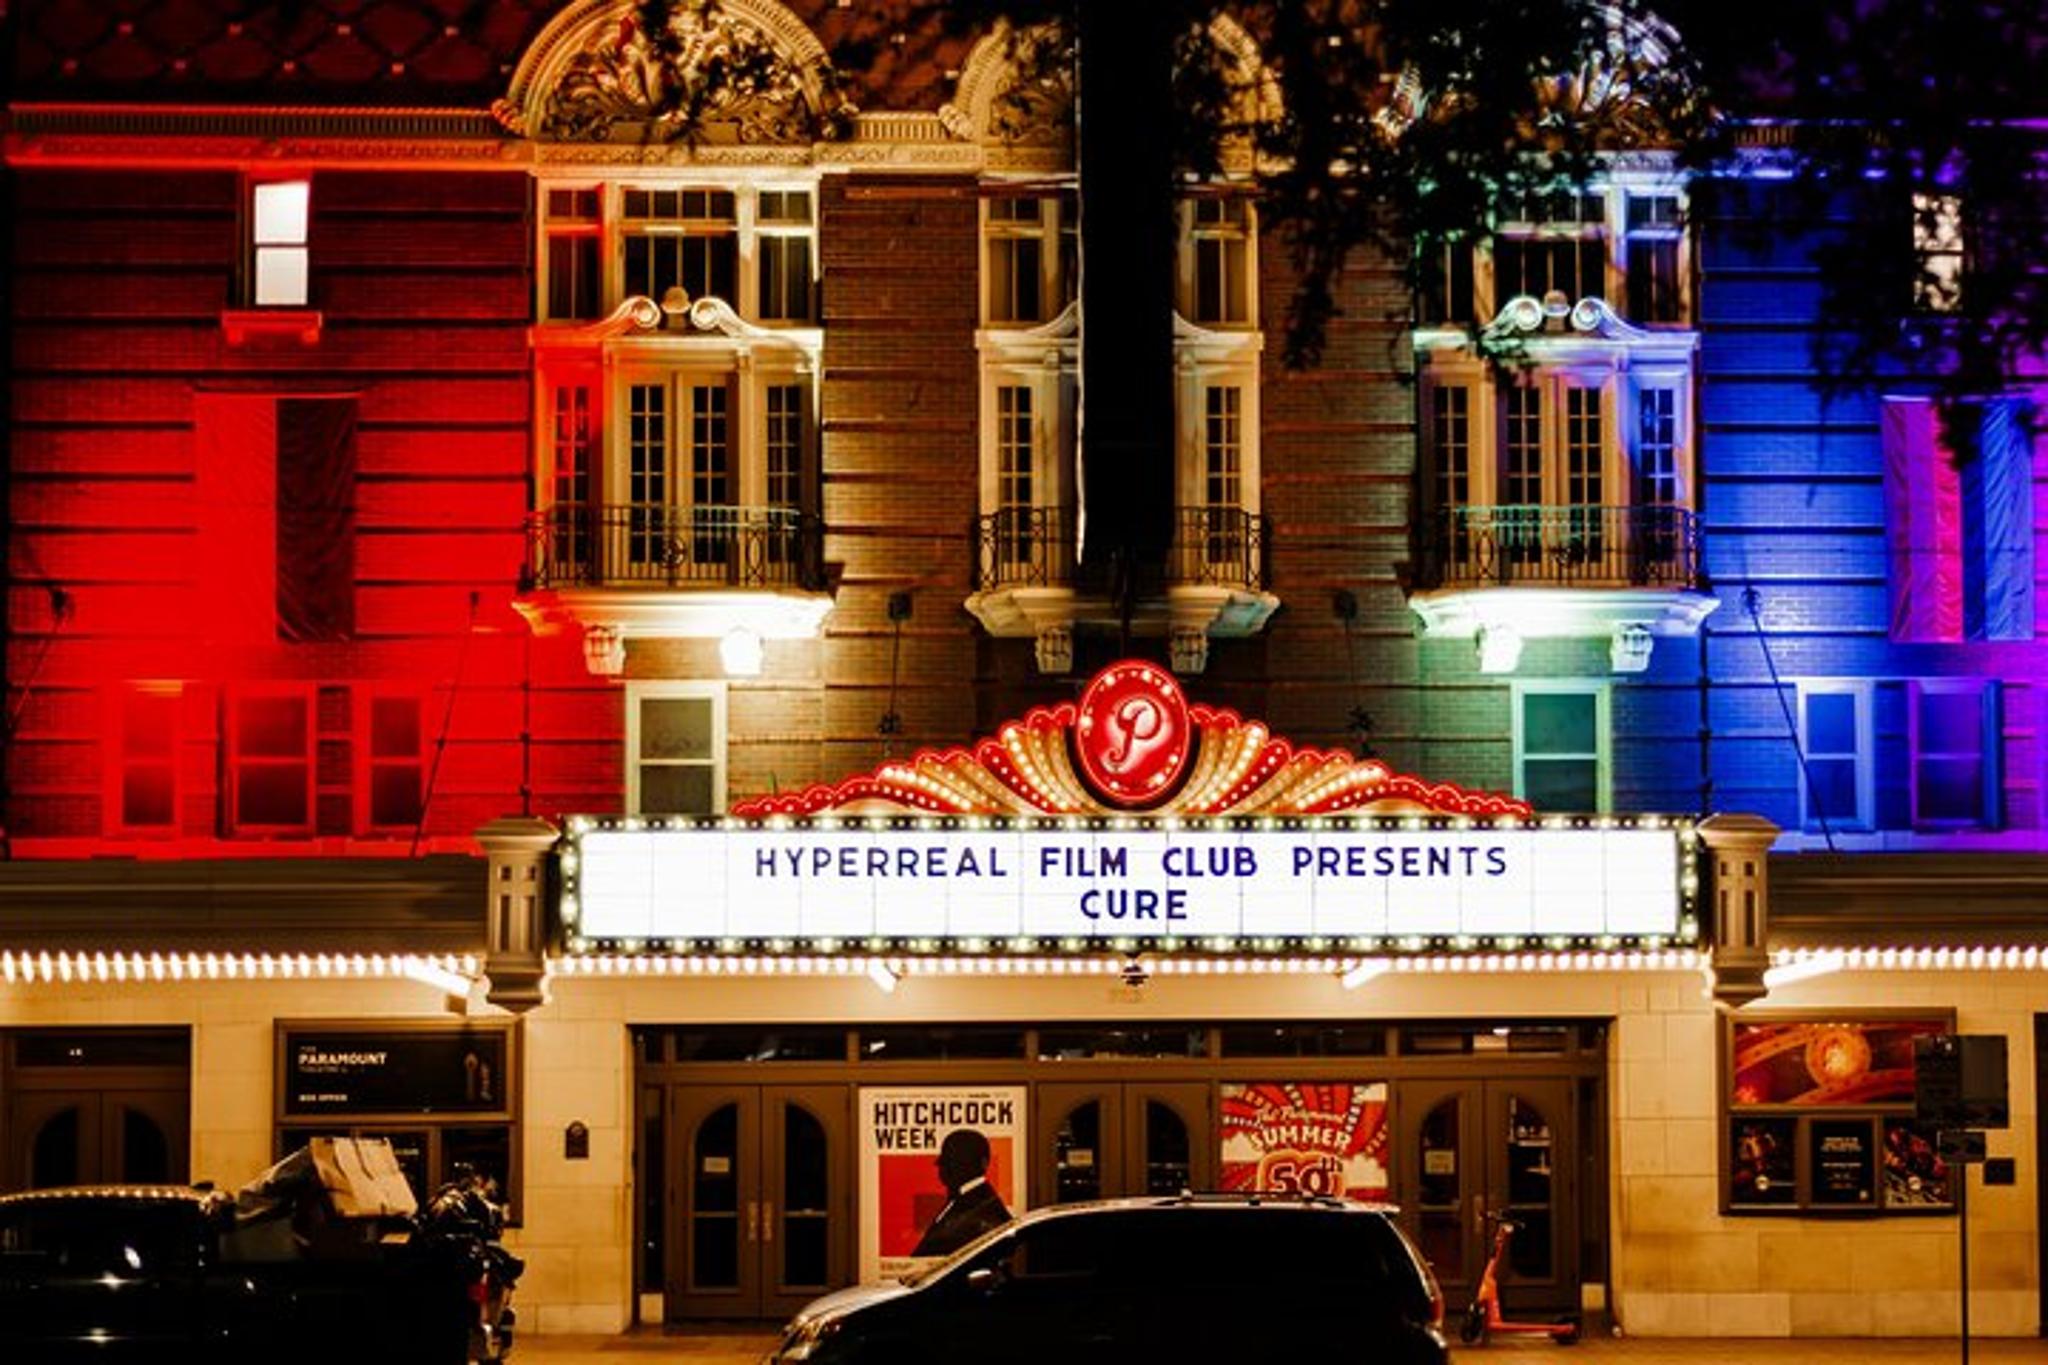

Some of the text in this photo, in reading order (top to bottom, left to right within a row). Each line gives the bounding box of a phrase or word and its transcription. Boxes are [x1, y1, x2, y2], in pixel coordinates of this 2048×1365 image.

[1105, 696, 1163, 766] P
[756, 846, 1506, 877] HYPERREAL FILM CLUB PRESENTS
[1080, 889, 1188, 920] CURE
[298, 1052, 387, 1065] PARAMOUNT
[874, 1101, 1013, 1126] HITCHCOCK
[875, 1127, 937, 1149] WEEK
[1250, 1125, 1352, 1151] SUMMER
